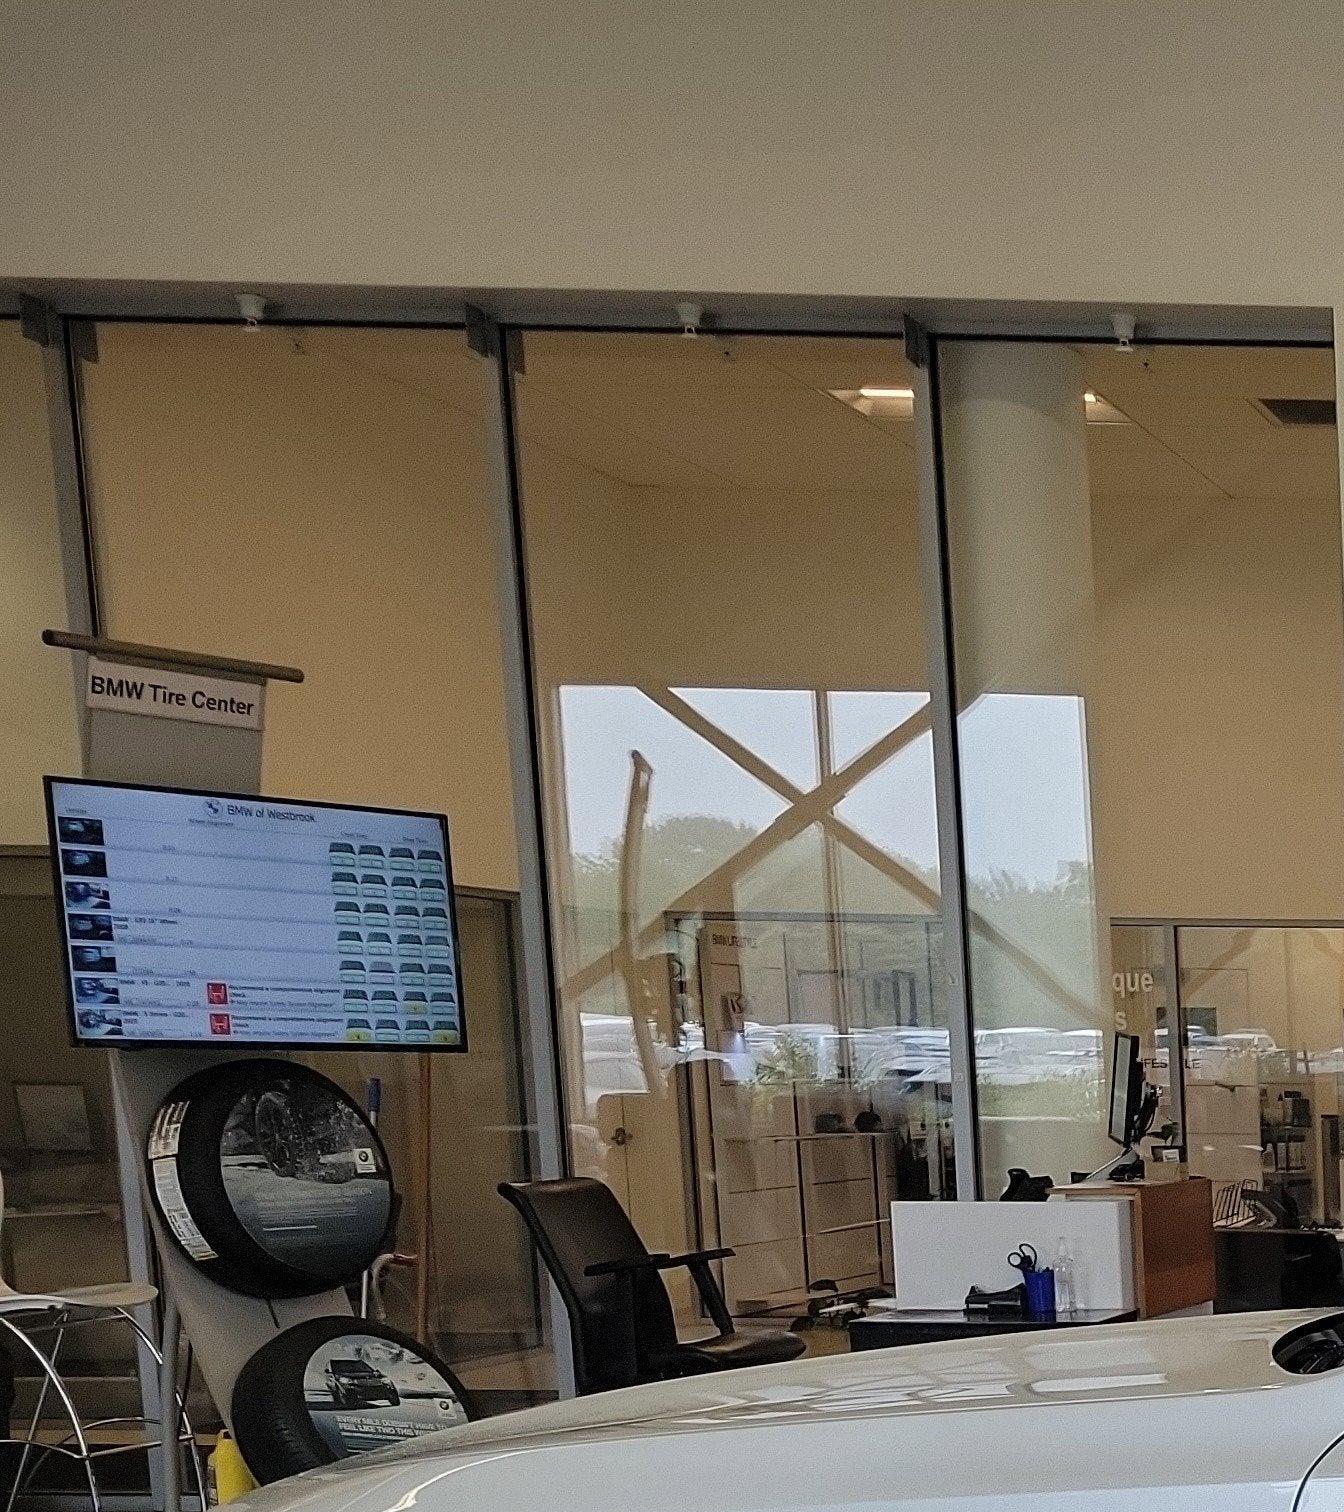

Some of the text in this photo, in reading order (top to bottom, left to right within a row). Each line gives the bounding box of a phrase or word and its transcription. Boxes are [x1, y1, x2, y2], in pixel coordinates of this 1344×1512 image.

[90, 675, 255, 716] BMW Tire Center
[227, 804, 317, 823] BMW of Westbrook
